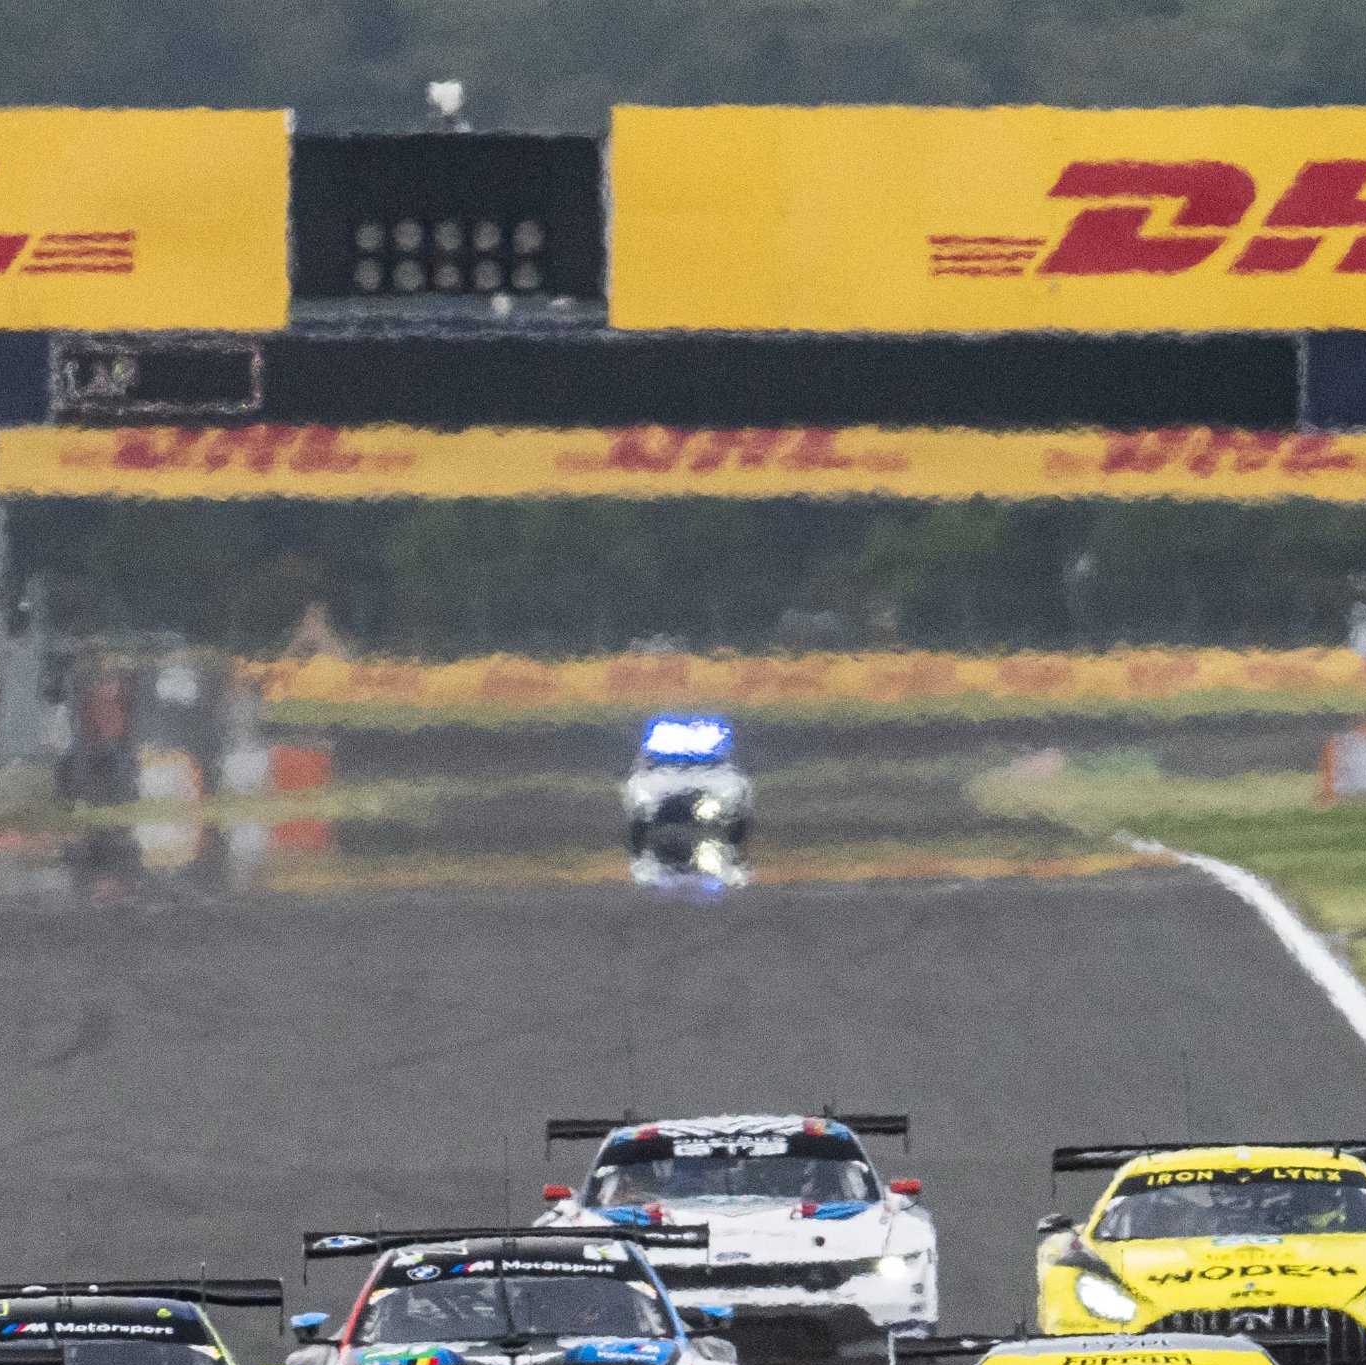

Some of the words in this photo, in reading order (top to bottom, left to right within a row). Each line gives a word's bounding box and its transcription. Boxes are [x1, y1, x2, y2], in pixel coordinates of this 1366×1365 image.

[1146, 1169, 1215, 1187] IRON
[1273, 1168, 1344, 1182] LYNX
[501, 1260, 616, 1273] Motorsport
[54, 1322, 176, 1335] Motorsport
